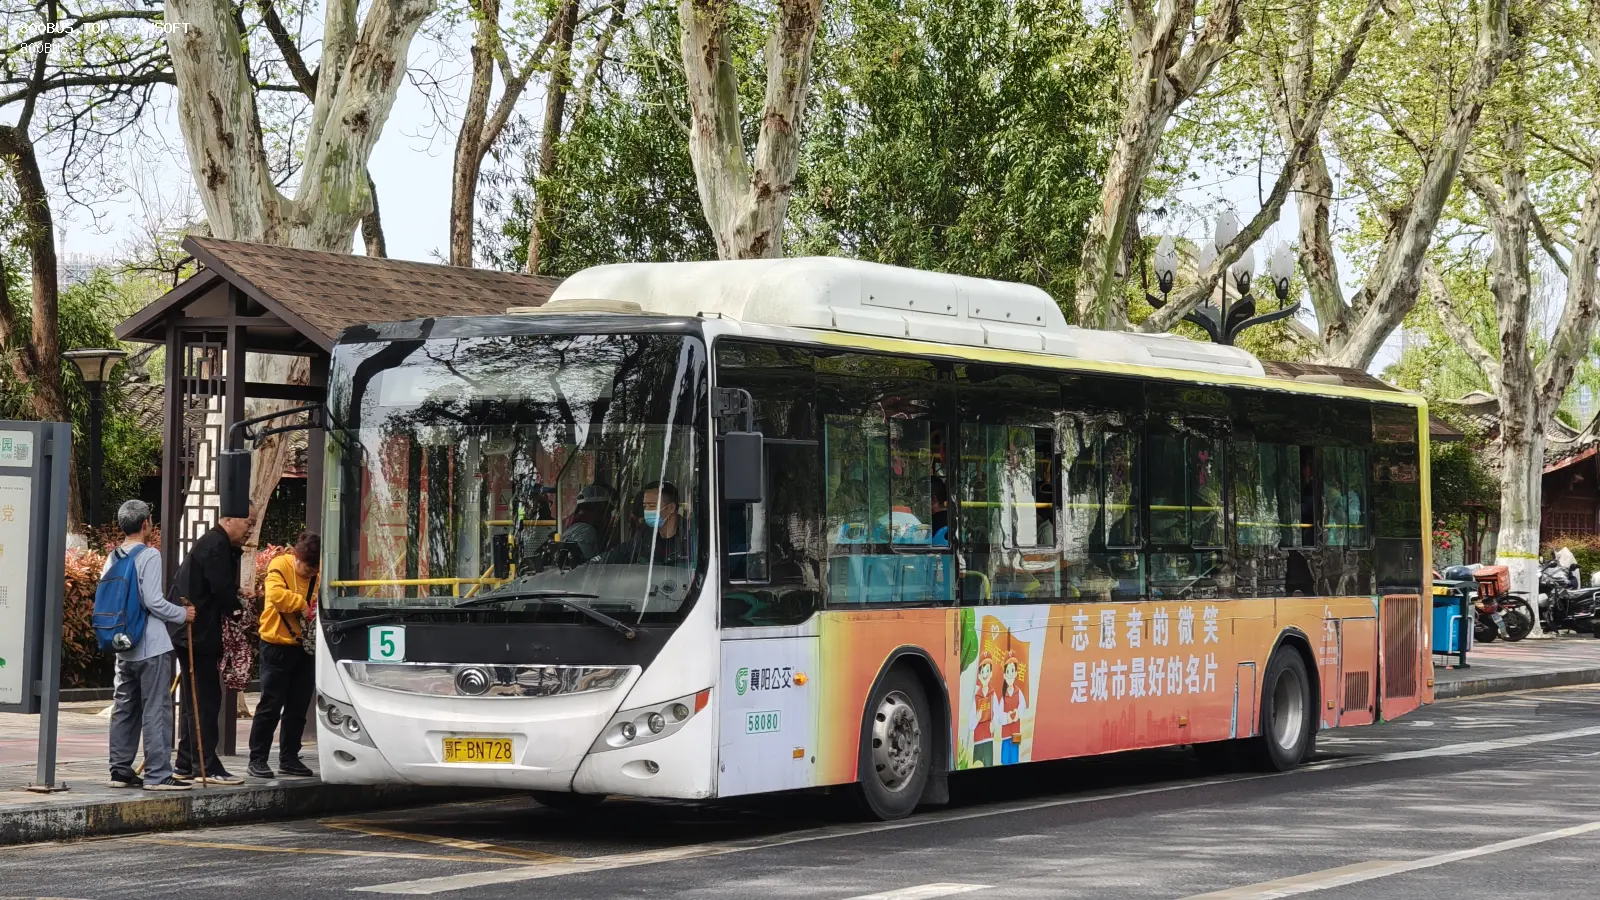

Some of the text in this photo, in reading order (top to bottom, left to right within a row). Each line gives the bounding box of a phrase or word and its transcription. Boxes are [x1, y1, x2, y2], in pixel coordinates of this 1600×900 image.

[1070, 604, 1220, 652] 志愿者的微笑
[380, 630, 396, 658] 5
[750, 666, 792, 692] 襄阳公交
[1070, 652, 1219, 704] 是城市最好的名片
[748, 713, 778, 732] 58080
